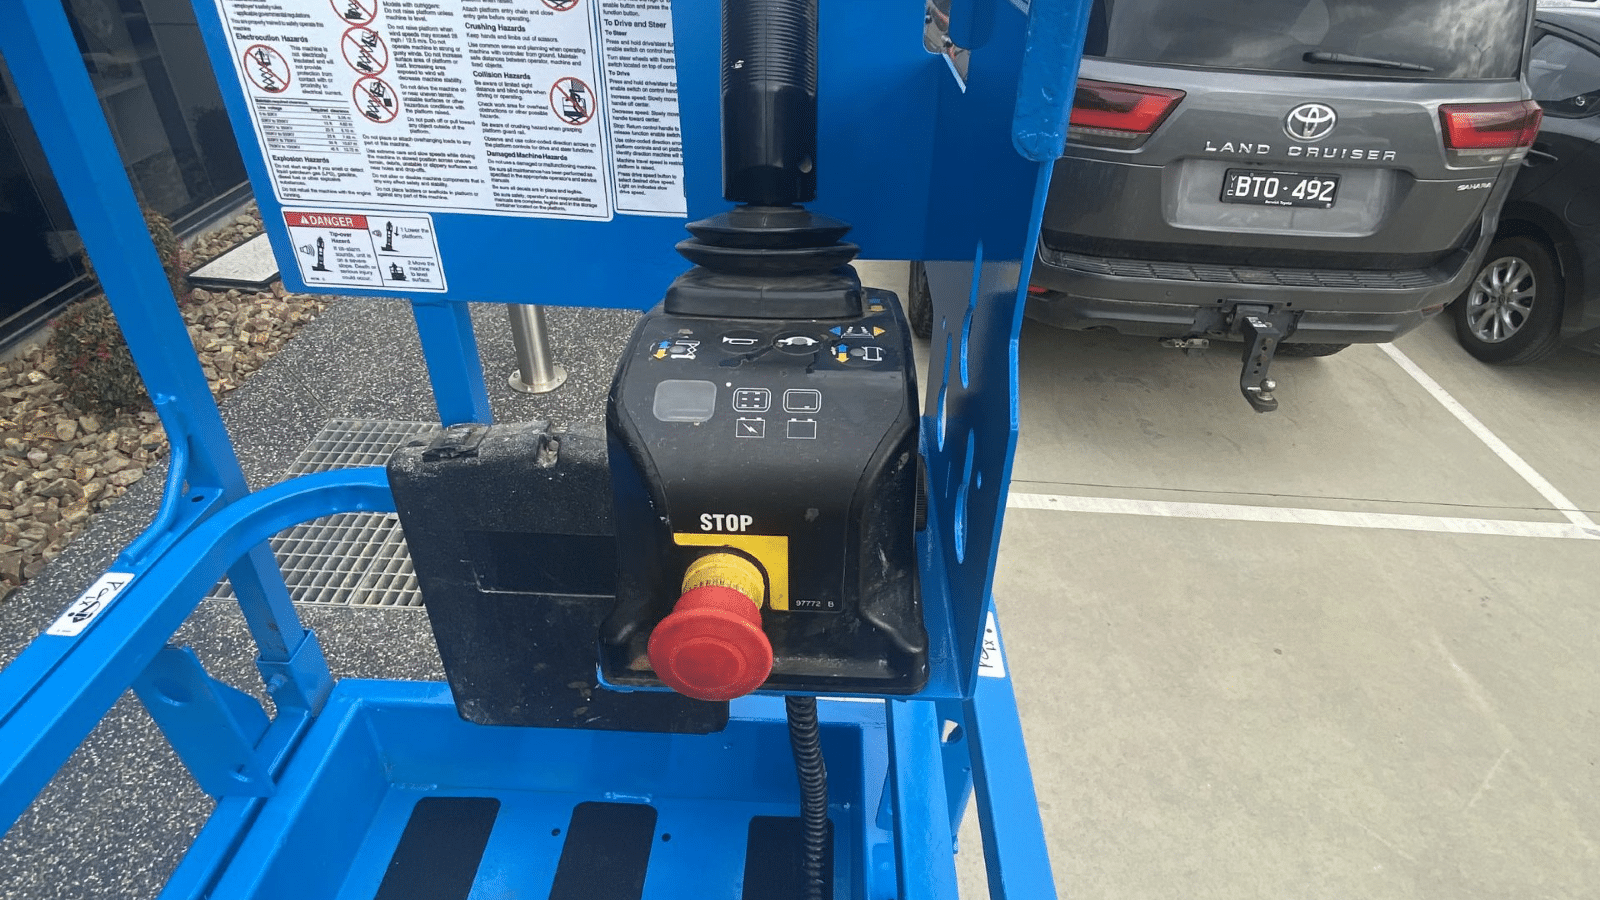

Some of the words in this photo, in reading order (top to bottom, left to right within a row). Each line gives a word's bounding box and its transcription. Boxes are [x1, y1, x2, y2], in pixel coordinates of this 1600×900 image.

[465, 22, 496, 32] Crushing
[236, 33, 279, 42] Electrocution
[487, 150, 515, 159] Damaged
[1205, 141, 1271, 154] LAND
[1288, 146, 1396, 160] CRUISER
[272, 154, 302, 163] Explosion
[1457, 182, 1491, 191] SAHARA
[310, 216, 352, 226] DANGER
[700, 513, 753, 532] STOP
